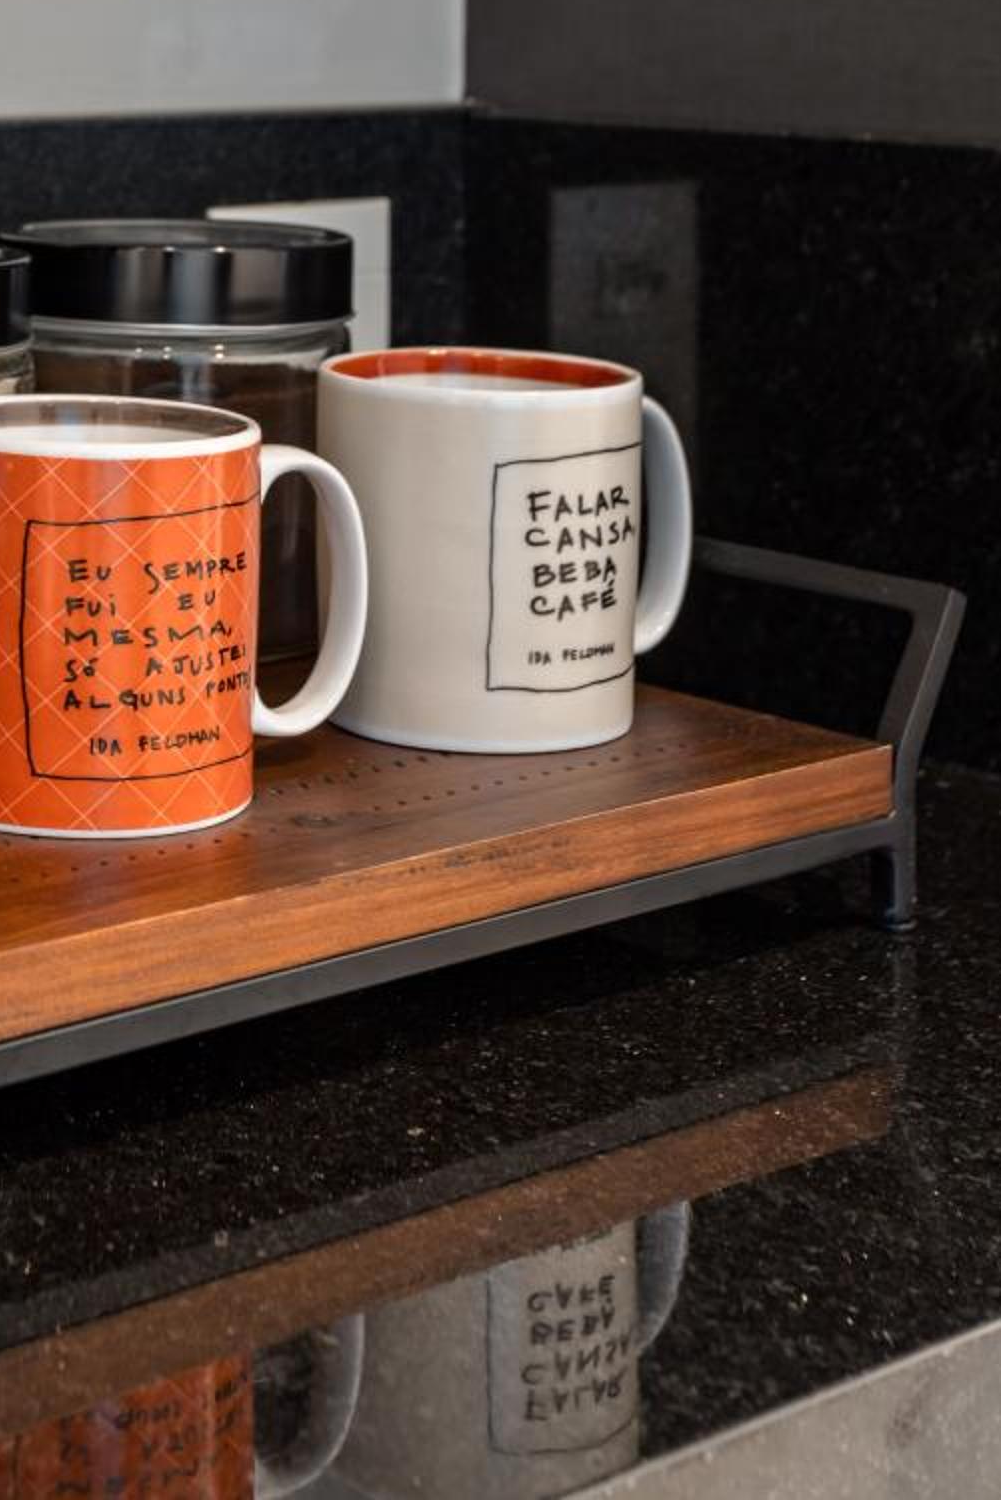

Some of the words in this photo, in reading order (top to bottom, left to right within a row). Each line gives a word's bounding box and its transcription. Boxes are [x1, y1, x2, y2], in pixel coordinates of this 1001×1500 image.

[527, 485, 630, 522] FALAR
[525, 516, 636, 554] CANSA
[68, 559, 111, 582] EU
[144, 551, 247, 594] SEMPRE
[533, 556, 617, 588] BEBA
[178, 590, 216, 611] EU
[529, 579, 617, 622] CAFÉ
[527, 650, 552, 667] IDA
[63, 687, 186, 711] ALGUNS
[89, 737, 122, 756] IDA
